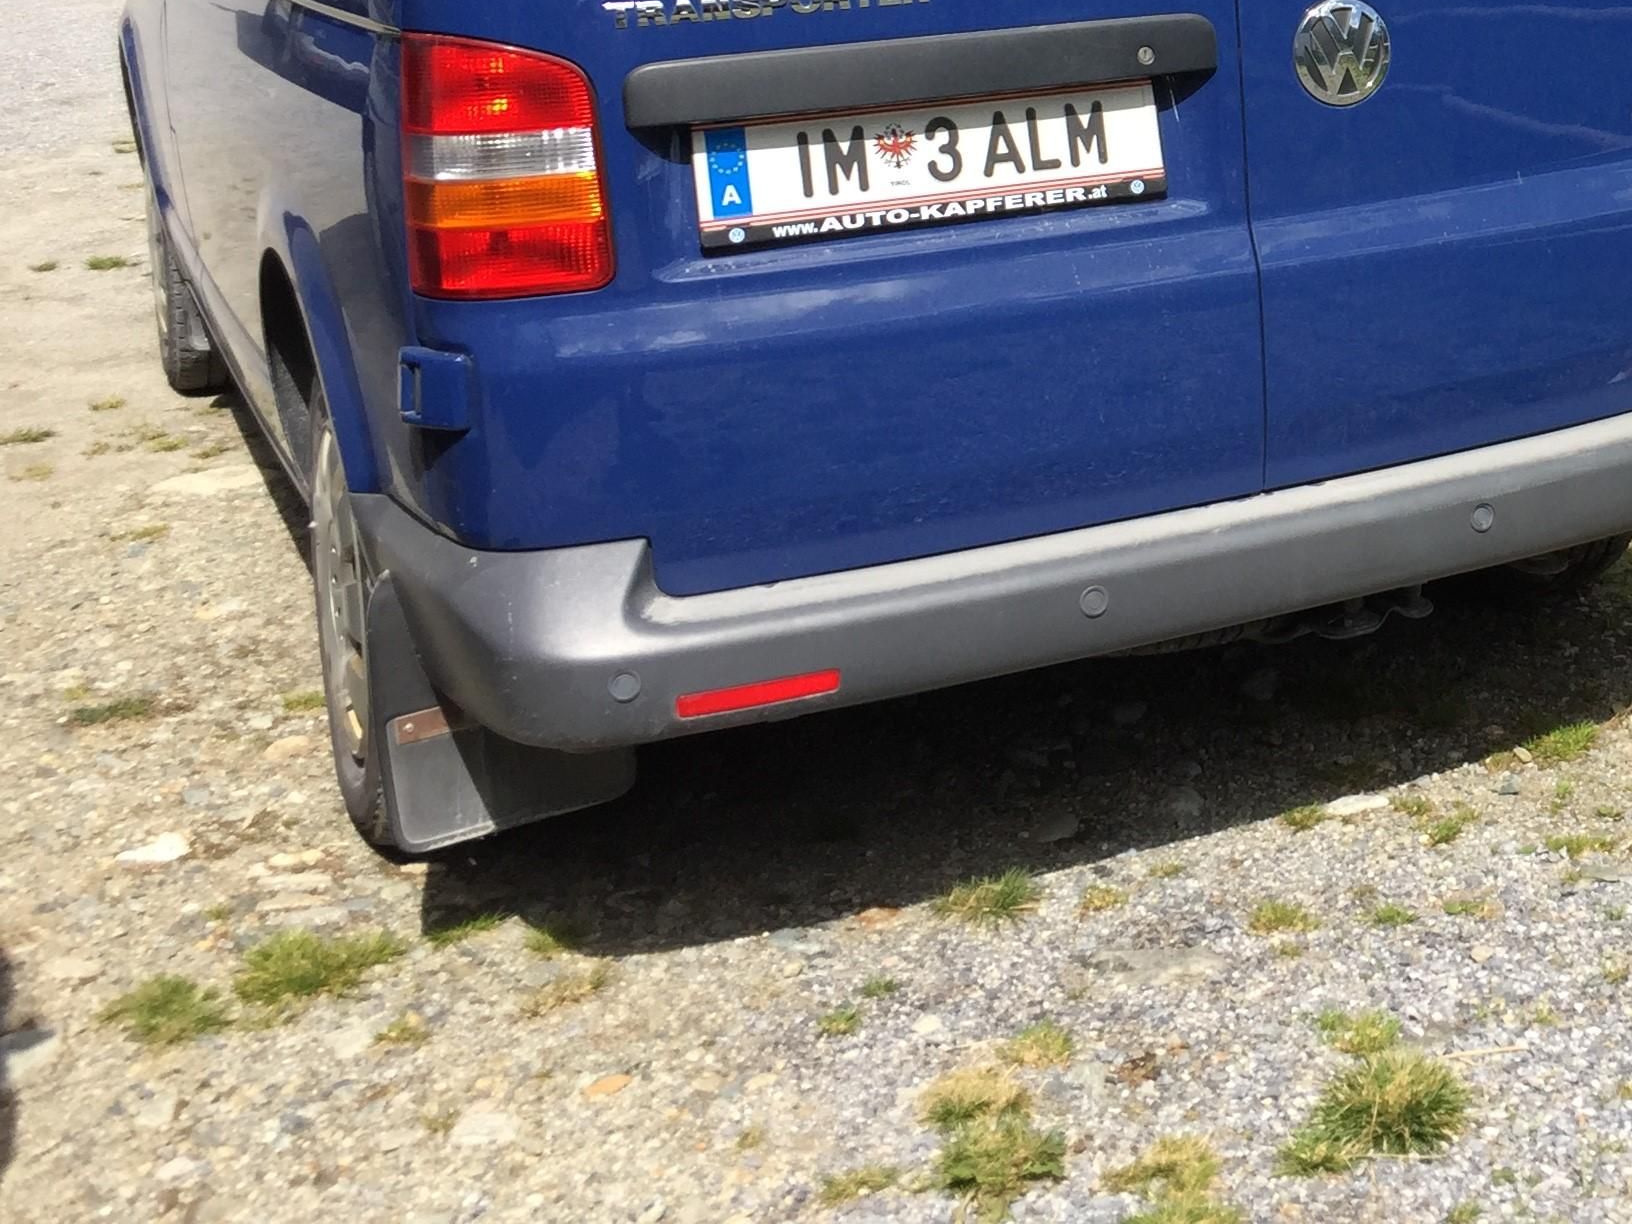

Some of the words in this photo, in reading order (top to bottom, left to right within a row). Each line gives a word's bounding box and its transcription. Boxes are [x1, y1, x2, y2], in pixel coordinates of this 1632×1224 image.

[797, 125, 870, 198] IM
[924, 116, 963, 182] 3
[983, 100, 1108, 177] ALM
[722, 184, 742, 206] A
[772, 183, 1108, 238] www.AUTO-KAPFERER.at
